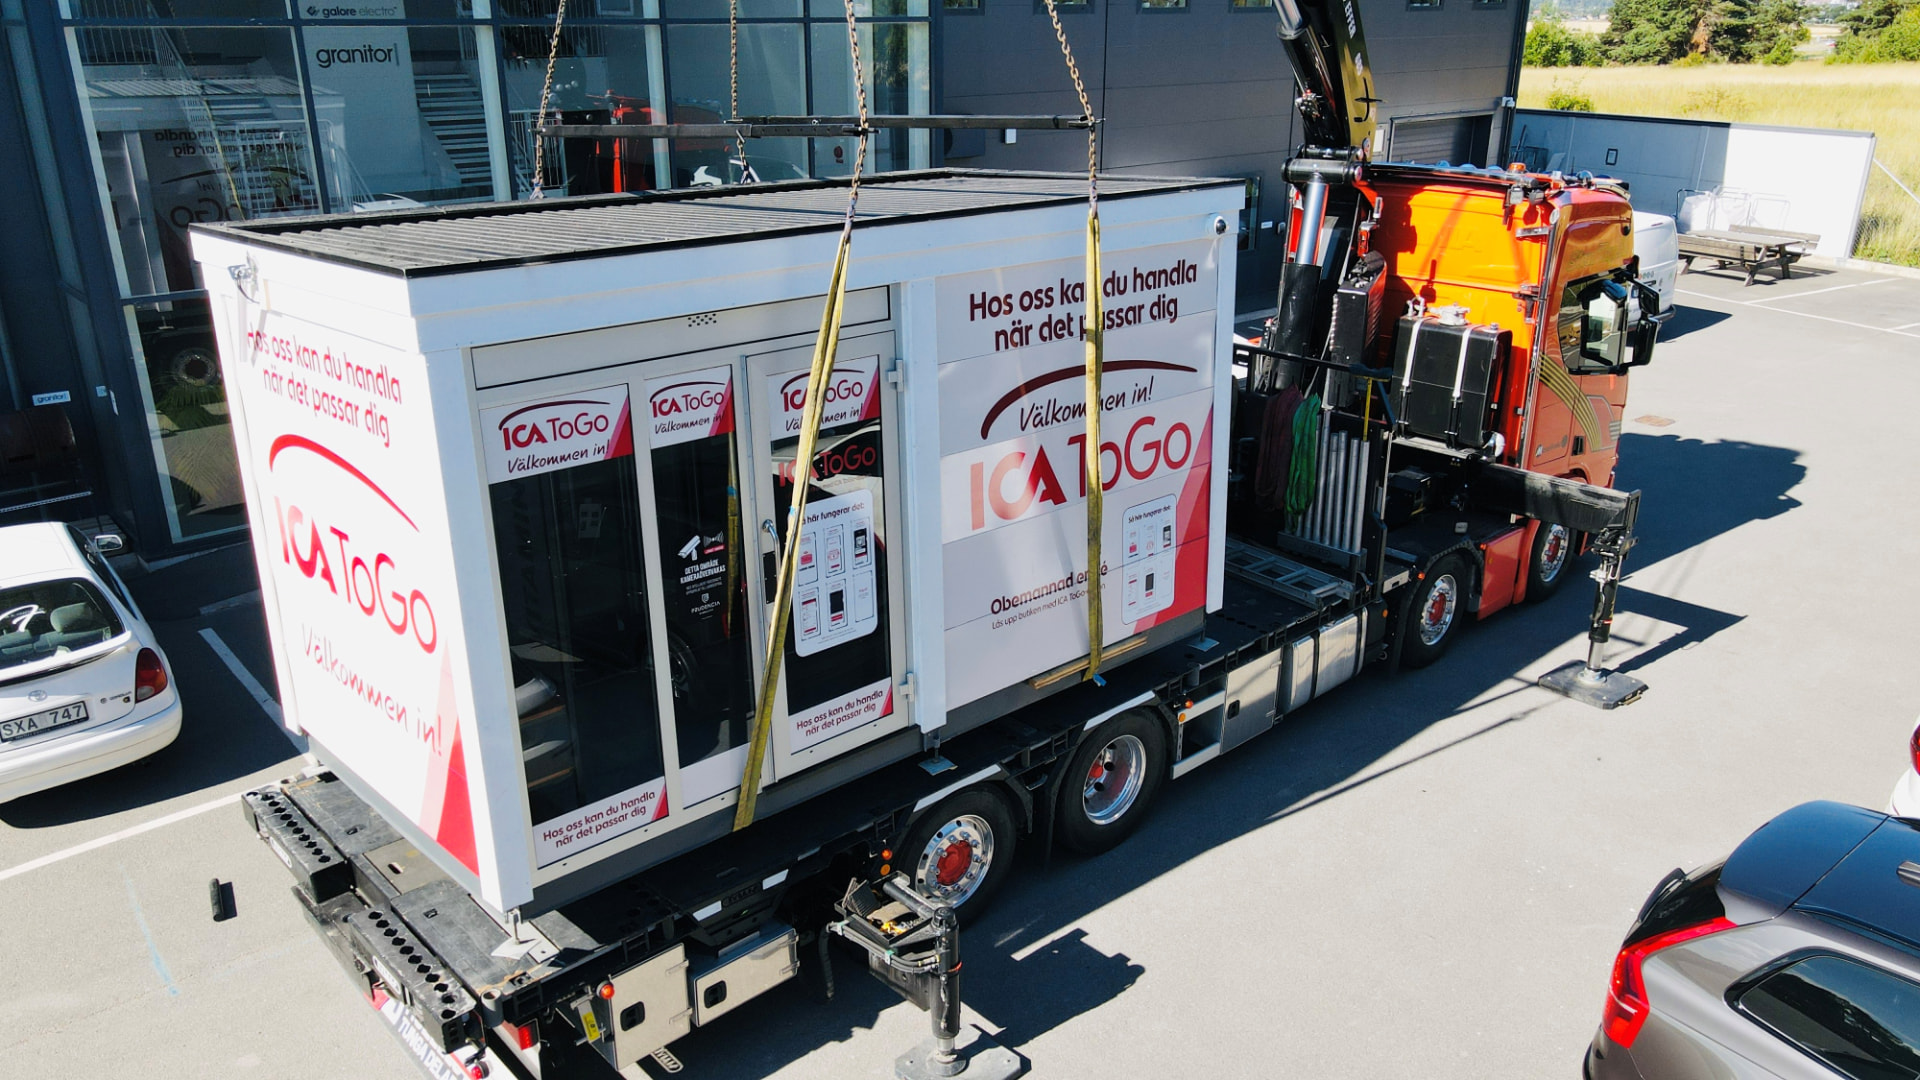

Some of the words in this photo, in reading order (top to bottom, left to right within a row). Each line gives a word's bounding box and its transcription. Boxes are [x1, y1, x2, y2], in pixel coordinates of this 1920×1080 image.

[322, 6, 357, 18] galore
[316, 44, 393, 69] granitor
[969, 291, 1013, 321] Hos
[1019, 286, 1054, 312] oss
[1060, 278, 1086, 305] ka
[1102, 270, 1128, 298] du
[1133, 259, 1197, 293] handla
[994, 319, 1033, 351] när
[1038, 312, 1074, 342] det
[1149, 294, 1178, 323] dig
[247, 322, 269, 355] Hos
[272, 336, 293, 363] oss
[293, 334, 321, 373] kan
[323, 345, 342, 381] du
[343, 351, 402, 405] handla
[263, 364, 283, 396] när
[287, 371, 309, 407] det
[312, 387, 359, 428] passar
[364, 401, 391, 448] dig
[652, 397, 683, 418] ICA
[681, 390, 724, 411] ToGo
[825, 379, 863, 403] oGo
[1131, 375, 1154, 405] in!
[503, 422, 548, 451] ICA
[546, 412, 609, 441] ToGo
[654, 417, 710, 434] Välkommen
[508, 448, 588, 473] Välkommen
[593, 438, 610, 456] in!
[818, 444, 876, 476] ToGo
[970, 445, 1067, 531] ICA
[1067, 416, 1192, 498] ToGo
[820, 506, 850, 519] fungerar
[274, 495, 338, 596] ICA
[329, 525, 438, 654] ToGo
[990, 571, 1074, 615] Obemannad
[1004, 614, 1018, 626] upp
[1018, 606, 1041, 620] butiken
[1042, 599, 1057, 610] med
[1057, 596, 1068, 605] ICA
[302, 622, 409, 733] Välkommen
[417, 707, 443, 757] in!
[2, 717, 38, 736] SXA
[49, 704, 82, 724] 747
[796, 718, 812, 730] Hos
[813, 712, 827, 723] oss
[828, 705, 843, 718] kan
[844, 701, 855, 711] du
[856, 690, 883, 707] handla
[805, 725, 819, 736] när
[821, 719, 835, 730] det
[836, 707, 862, 725] passar
[863, 703, 876, 713] dig
[543, 827, 564, 841] Hos
[565, 820, 583, 832] oss
[584, 811, 604, 825] kan
[606, 805, 619, 816] du
[620, 791, 655, 811] handla
[555, 833, 573, 848] när
[576, 826, 593, 839] det
[595, 812, 628, 834] passar
[630, 805, 646, 817] dig
